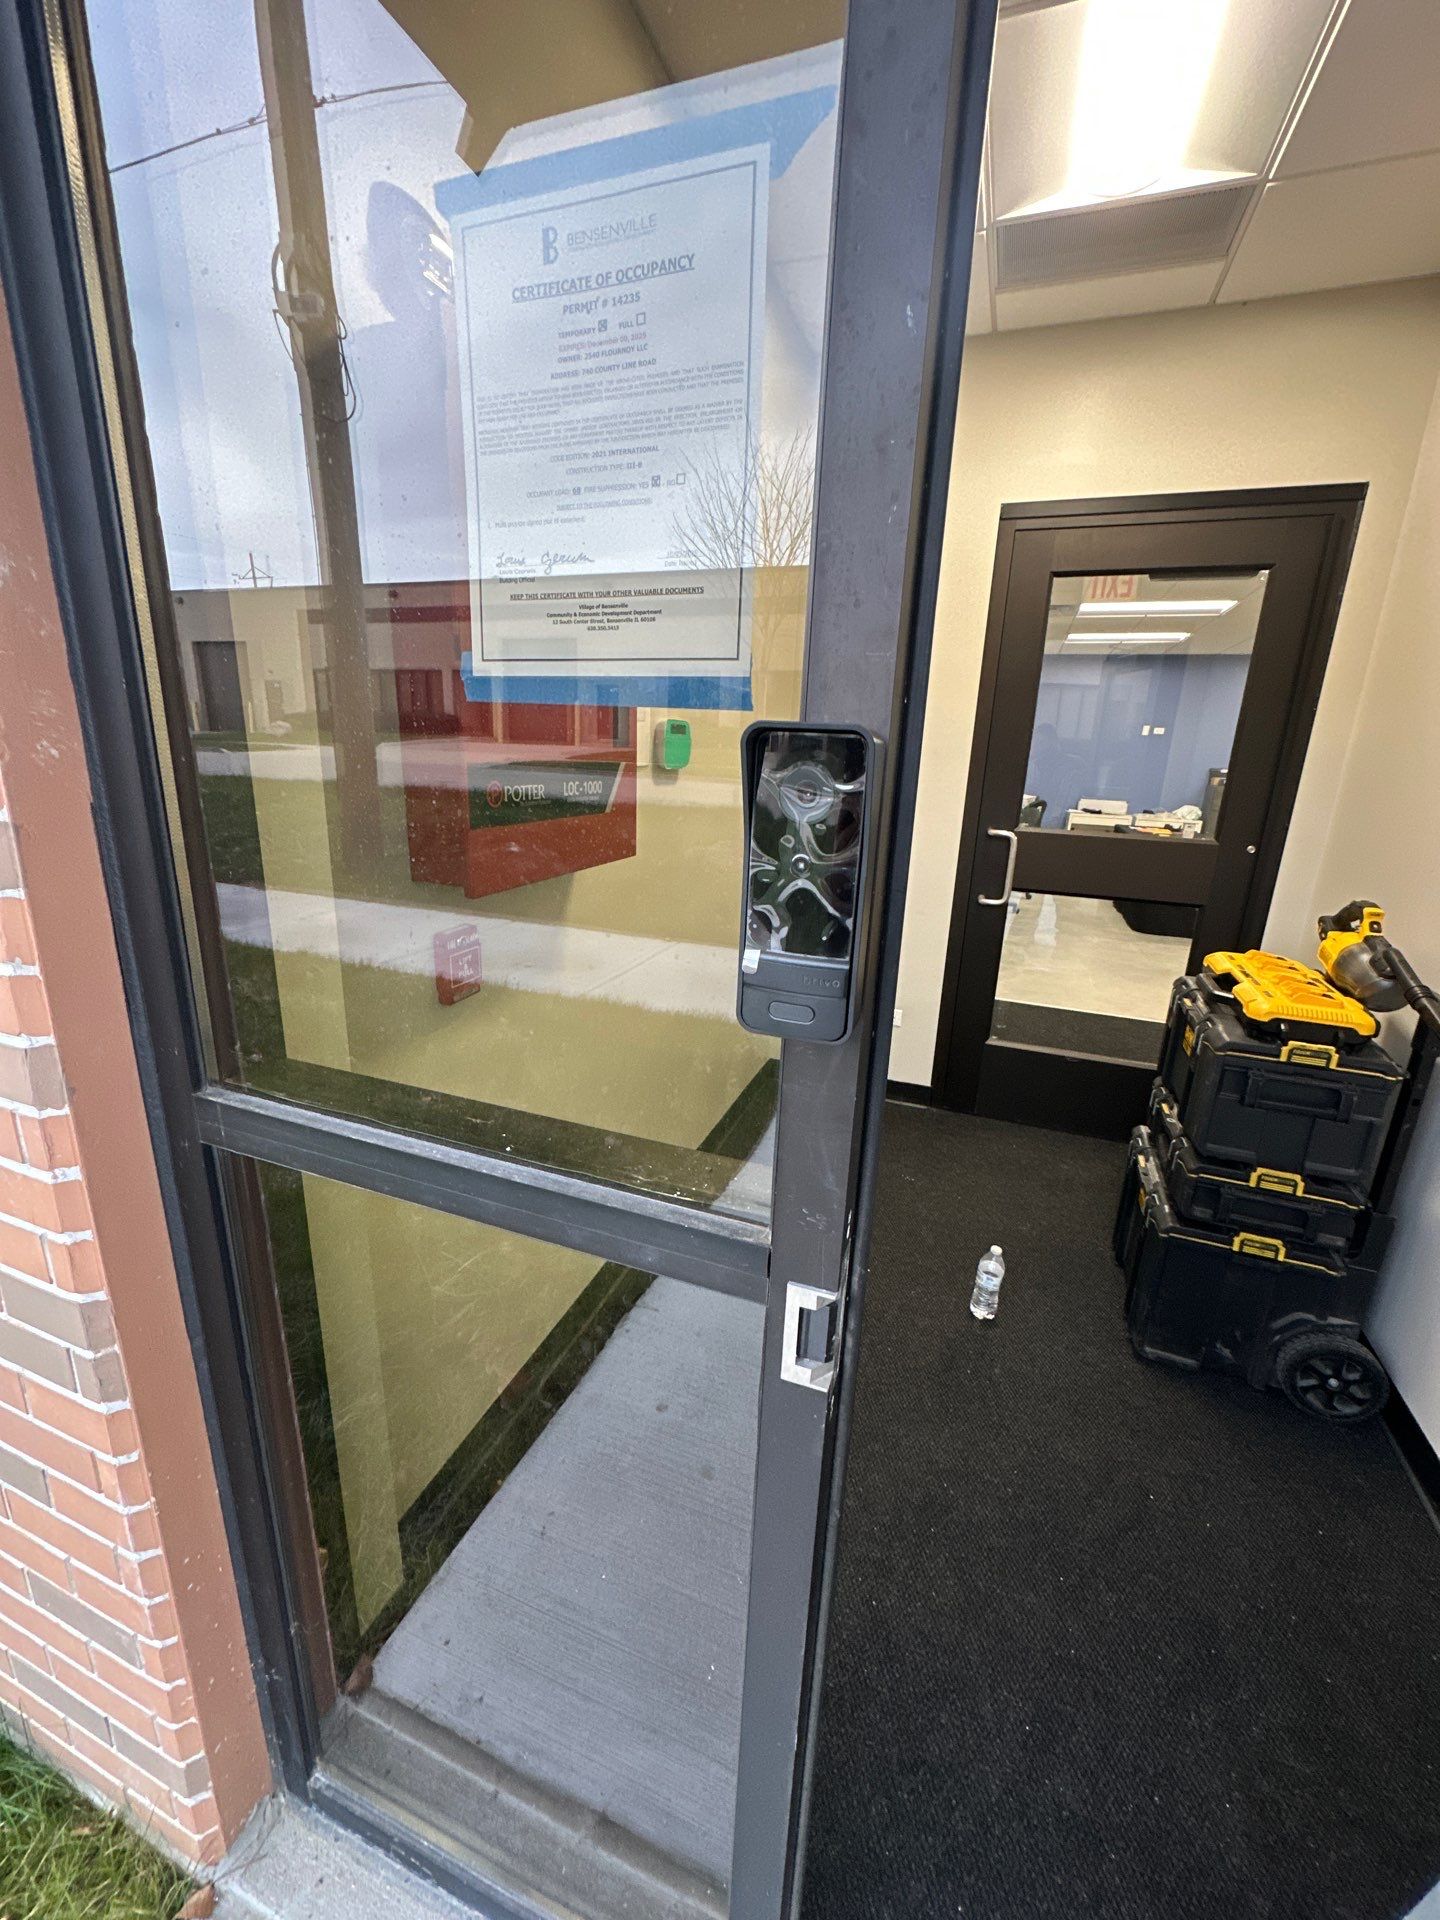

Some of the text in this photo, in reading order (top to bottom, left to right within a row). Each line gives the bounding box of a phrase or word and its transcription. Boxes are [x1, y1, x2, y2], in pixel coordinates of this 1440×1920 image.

[566, 213, 658, 247] BENSENVILLE
[512, 255, 694, 303] CERTIFICATE OF OCCUPANCY
[562, 299, 596, 315] PERMIT
[611, 291, 640, 306] 14235
[618, 320, 634, 329] FULL
[557, 353, 582, 363] OWNER:
[636, 343, 648, 351] LLC
[594, 363, 620, 373] COUNTY
[621, 361, 636, 369] LINE
[638, 358, 657, 367] ROAD
[607, 445, 659, 456] INTERNATIONAL
[565, 464, 608, 474] CONSTRUCTION
[664, 587, 704, 595] DOCUMENTS
[504, 784, 546, 803] POTTER
[563, 780, 604, 797] LOC-1000
